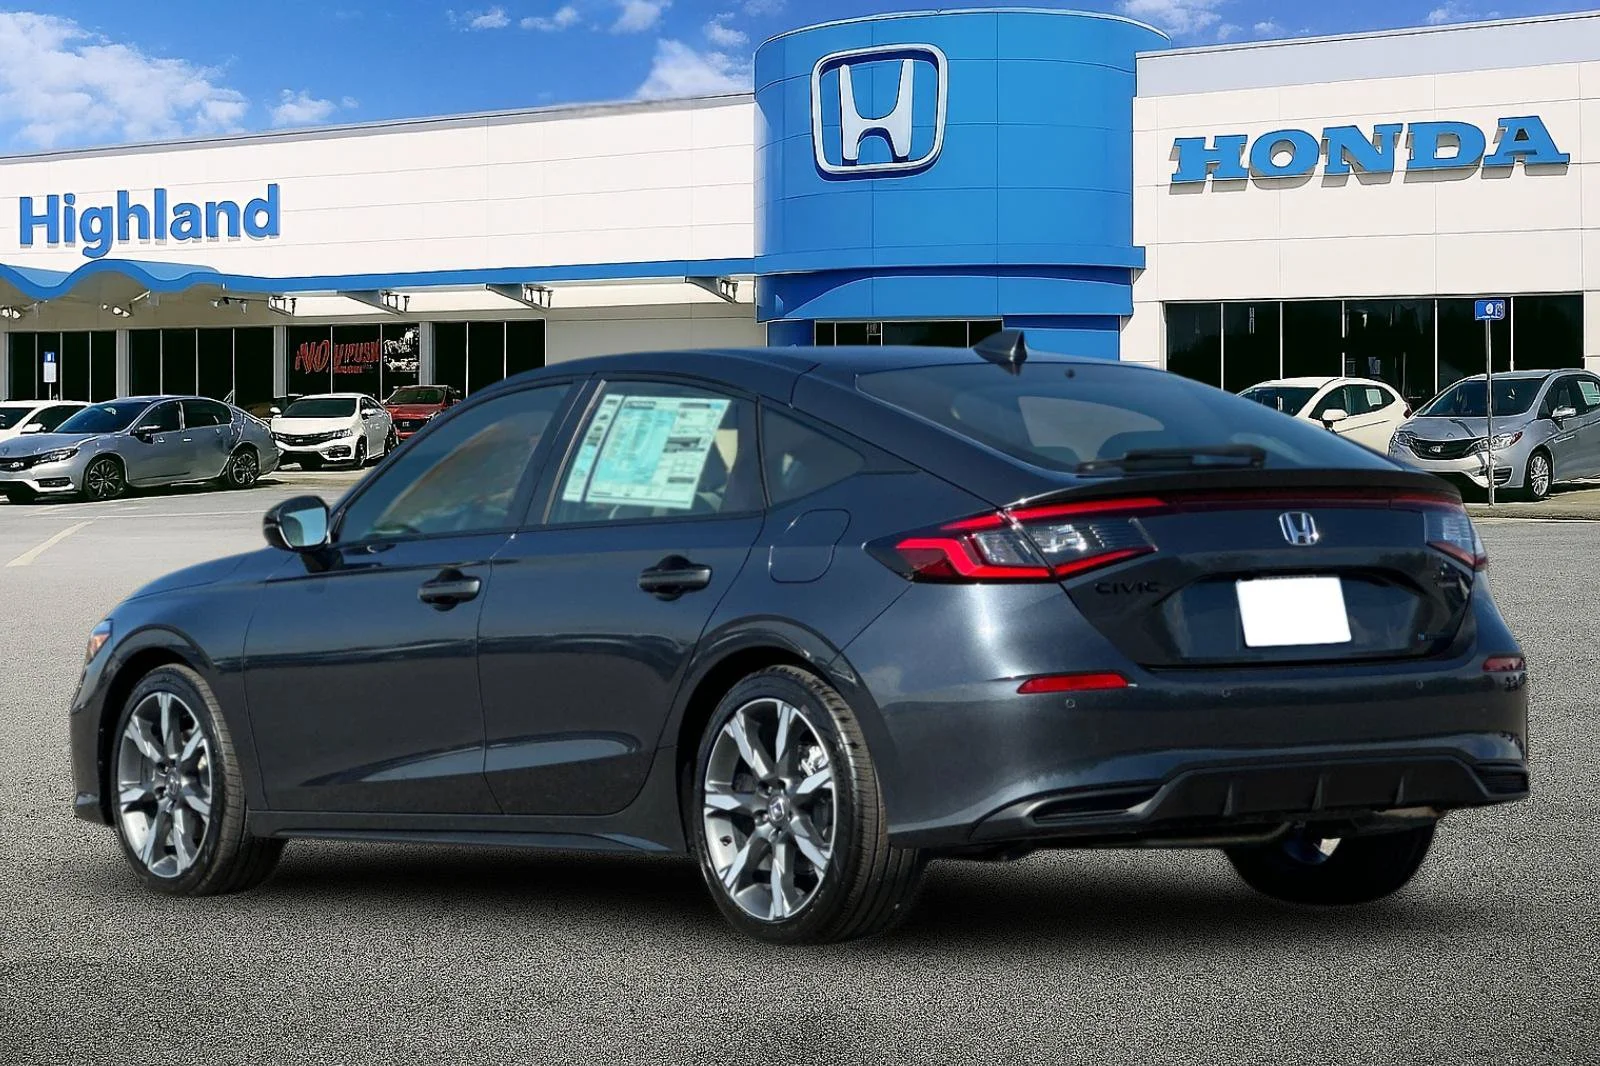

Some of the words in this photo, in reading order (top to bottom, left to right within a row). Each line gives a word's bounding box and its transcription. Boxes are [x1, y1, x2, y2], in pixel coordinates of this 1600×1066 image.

[1171, 115, 1570, 184] HONDA
[19, 183, 281, 258] Highland
[1095, 580, 1159, 595] CIVIC
